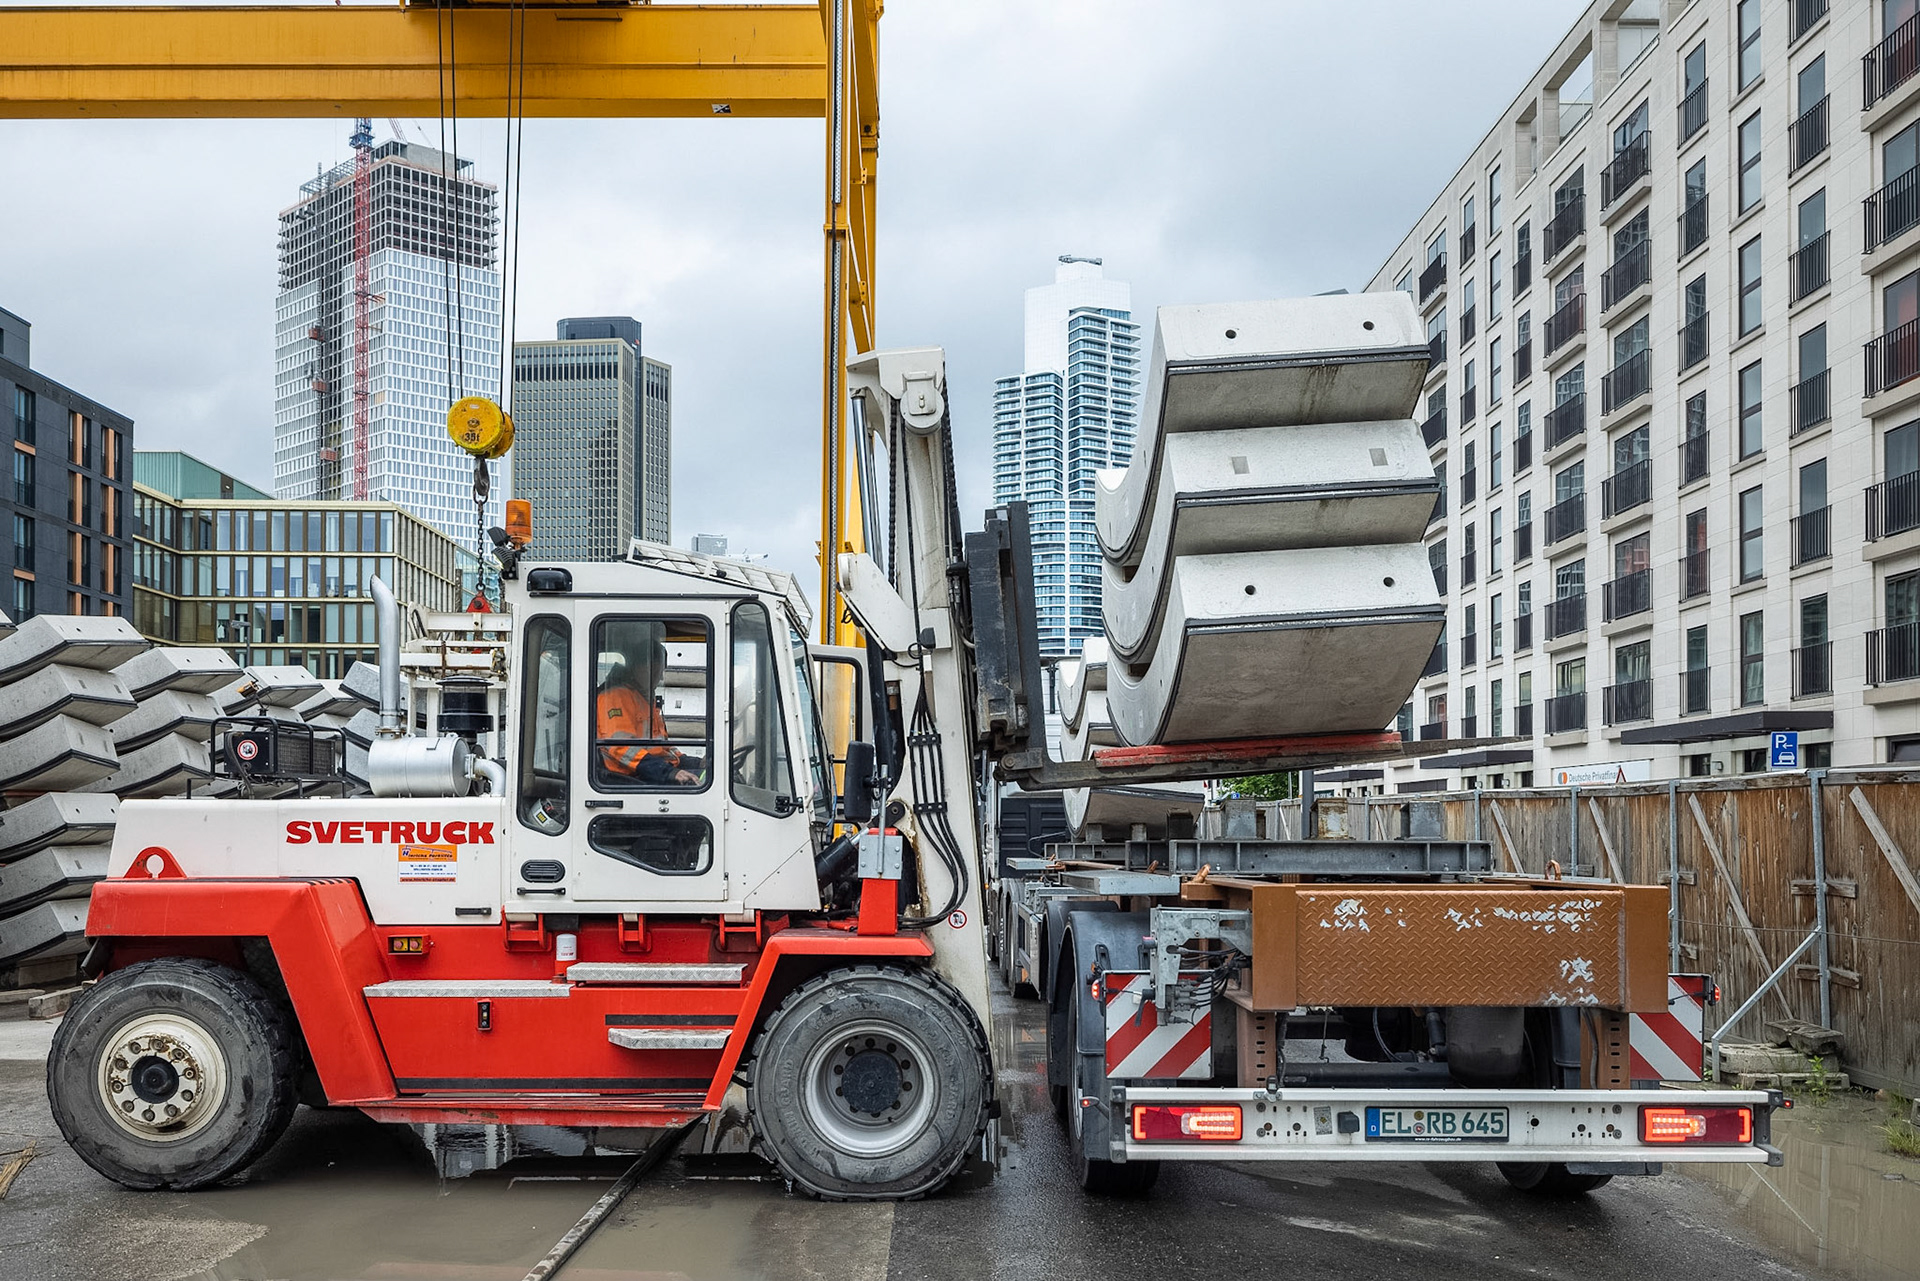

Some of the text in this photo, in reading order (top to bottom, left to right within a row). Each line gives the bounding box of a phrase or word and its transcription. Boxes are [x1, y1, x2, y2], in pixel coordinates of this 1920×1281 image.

[1775, 734, 1787, 748] P
[286, 820, 494, 844] SVETRUCK
[1382, 1112, 1504, 1134] EL RB 645
